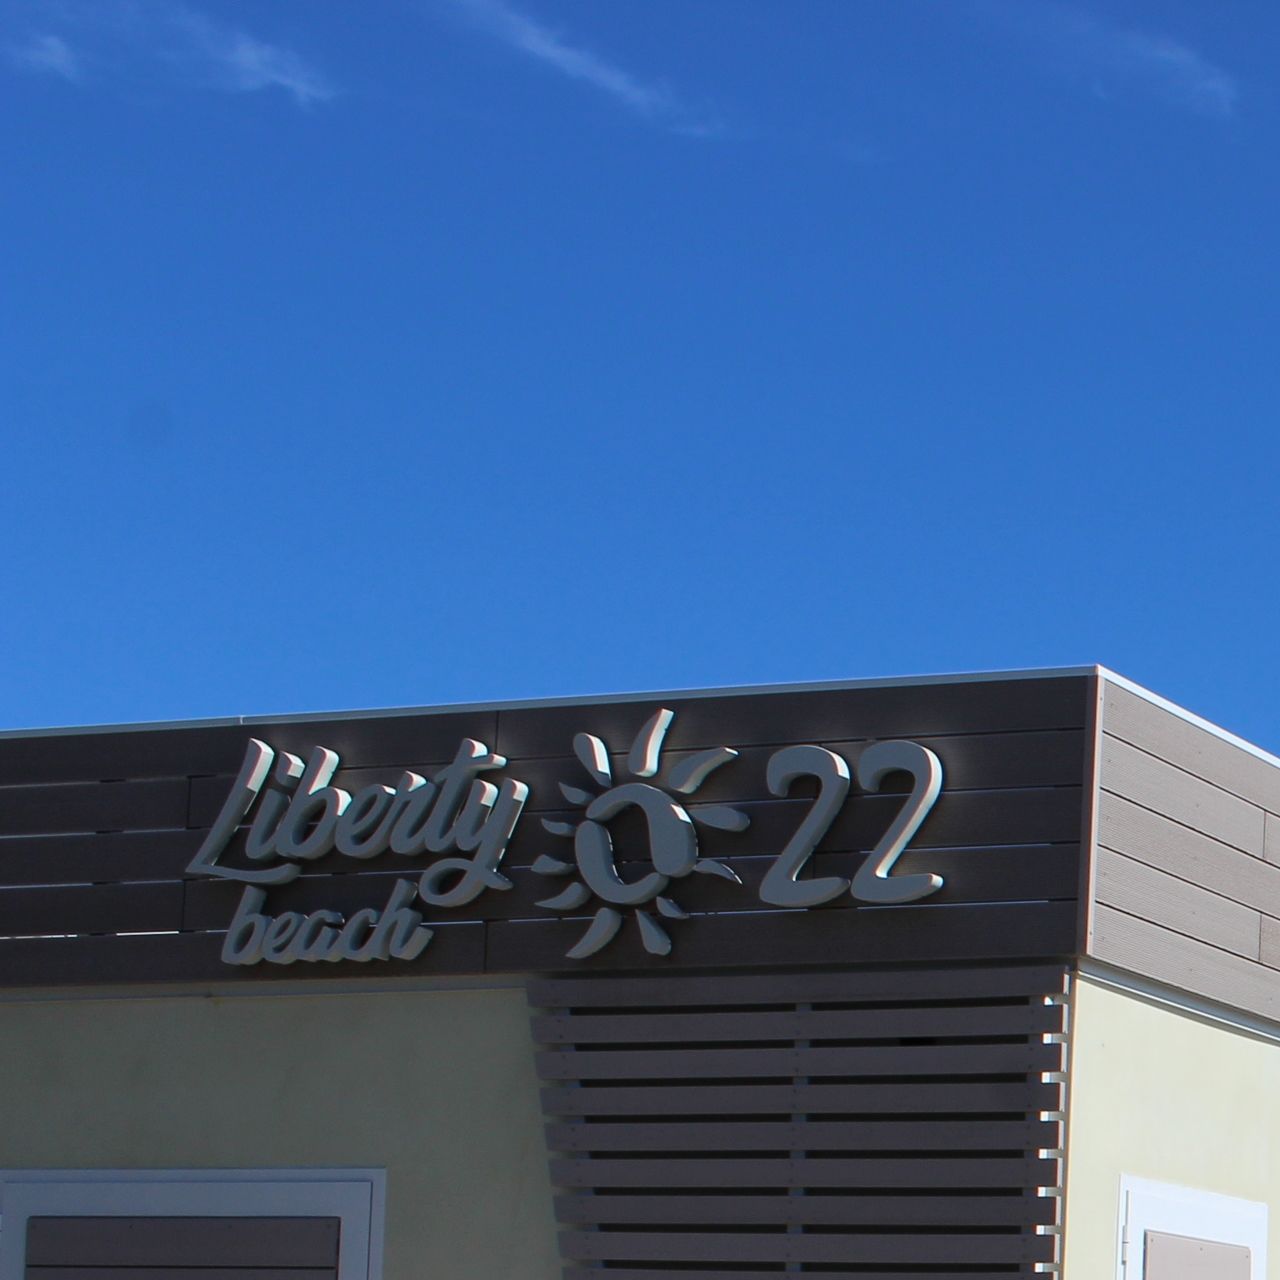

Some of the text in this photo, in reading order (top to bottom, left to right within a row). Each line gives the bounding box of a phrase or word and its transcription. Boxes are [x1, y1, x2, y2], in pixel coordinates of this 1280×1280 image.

[186, 738, 529, 908] Liberty
[760, 740, 944, 908] 22
[221, 879, 434, 966] beach
